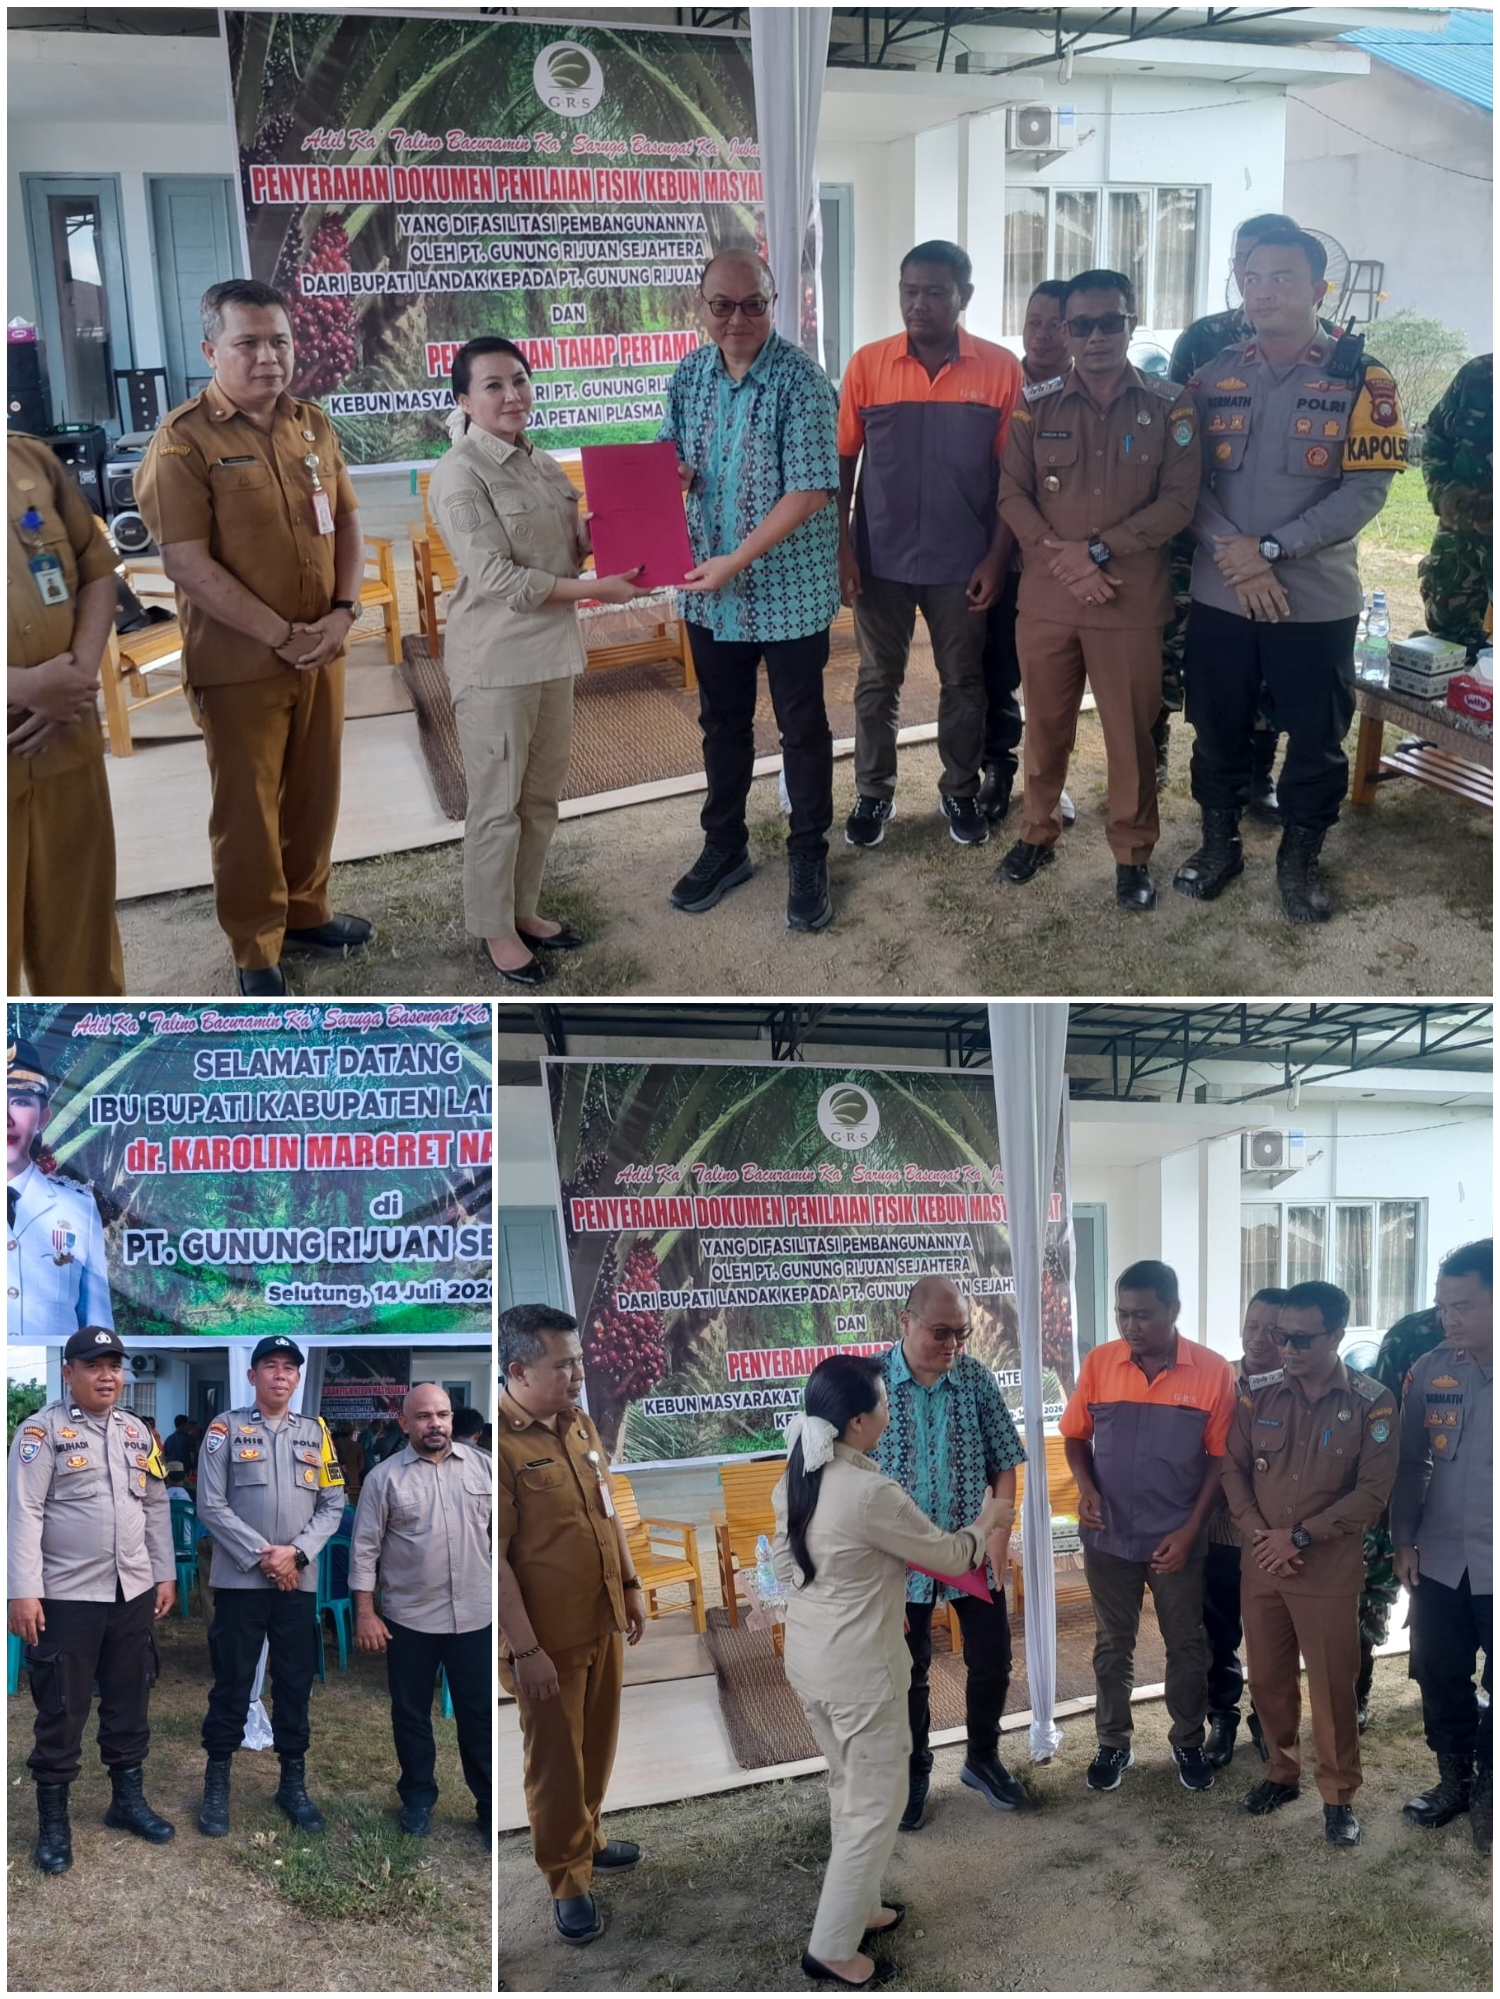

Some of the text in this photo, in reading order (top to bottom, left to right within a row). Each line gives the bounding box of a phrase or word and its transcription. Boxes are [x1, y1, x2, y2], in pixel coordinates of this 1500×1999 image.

[303, 129, 344, 150] Adil
[391, 130, 442, 150] Talino
[447, 131, 530, 152] Bacuramin
[572, 134, 627, 158] Saruga
[632, 135, 695, 160] Basengat
[252, 167, 390, 201] PENYERAHAN
[393, 168, 492, 201] DOKUMEN
[497, 168, 592, 201] PENILAIAN
[597, 169, 641, 201] FISIK
[645, 170, 699, 201] KEBUN
[401, 214, 706, 233] YANG DIFASILITASI PEMBANGUNANNYA
[411, 241, 705, 262] OLEH PT. GUNUNG RIJUAN SEJAHTERA
[303, 266, 702, 294] DARI BUPATI LANDAK KEPADA PT. GUNUNG RIJUAN
[552, 304, 586, 323] DAN
[557, 336, 616, 369] TAHAP
[620, 332, 699, 365] PERTAMA
[331, 394, 392, 414] KEBUN
[396, 389, 455, 411] MASYA
[554, 384, 578, 401] PT.
[581, 381, 644, 398] GUNUNG
[1296, 398, 1346, 413] POLRI
[549, 407, 603, 425] PETANI
[606, 403, 664, 422] PLASMA
[73, 1014, 110, 1036] Adil
[149, 1012, 197, 1034] Talino
[201, 1011, 281, 1032] Bacuramin
[323, 1010, 382, 1033] Saruga
[387, 1005, 459, 1029] Basengat
[196, 1045, 461, 1079] SELAMAT DATANG
[92, 1096, 139, 1123] IBU
[147, 1094, 251, 1122] BUPATI
[260, 1089, 438, 1120] KABUPATEN
[126, 1139, 164, 1172] dr.
[171, 1135, 298, 1171] KAROLIN
[306, 1133, 452, 1168] MARGRET
[615, 1163, 652, 1183] Adil
[692, 1164, 739, 1183] Talino
[743, 1163, 815, 1183] Bacuramin
[852, 1165, 901, 1186] Saruga
[905, 1164, 959, 1186] Basengat
[372, 1192, 399, 1216] di
[572, 1198, 694, 1230] PENYERAHAN
[696, 1197, 784, 1228] DOKUMEN
[787, 1196, 871, 1226] PENILAIAN
[875, 1196, 914, 1225] FISIK
[918, 1195, 967, 1224] KEBUN
[127, 1233, 175, 1263] PT.
[182, 1232, 322, 1261] GUNUNG
[331, 1229, 449, 1259] RIJUAN
[702, 1234, 972, 1257] YANG DIFASILITASI PEMBANGUNANNYA
[712, 1257, 971, 1281] OLEH PT. GUNUNG RIJUAN SEJAHTERA
[268, 1282, 492, 1305] Selutung, 14 Juli 202
[618, 1293, 658, 1310] DARI
[662, 1291, 714, 1309] BUPATI
[719, 1289, 779, 1306] LANDAK
[782, 1287, 838, 1303] KEPADA
[842, 1285, 864, 1301] PT.
[866, 1283, 912, 1299] GUNUN
[838, 1316, 867, 1332] DAN
[644, 1399, 698, 1415] KEBUN
[701, 1389, 799, 1411] MASYARAKAT
[1044, 1405, 1064, 1414] 2026
[55, 1441, 90, 1453] MUHADI
[292, 1440, 320, 1449] POLRI
